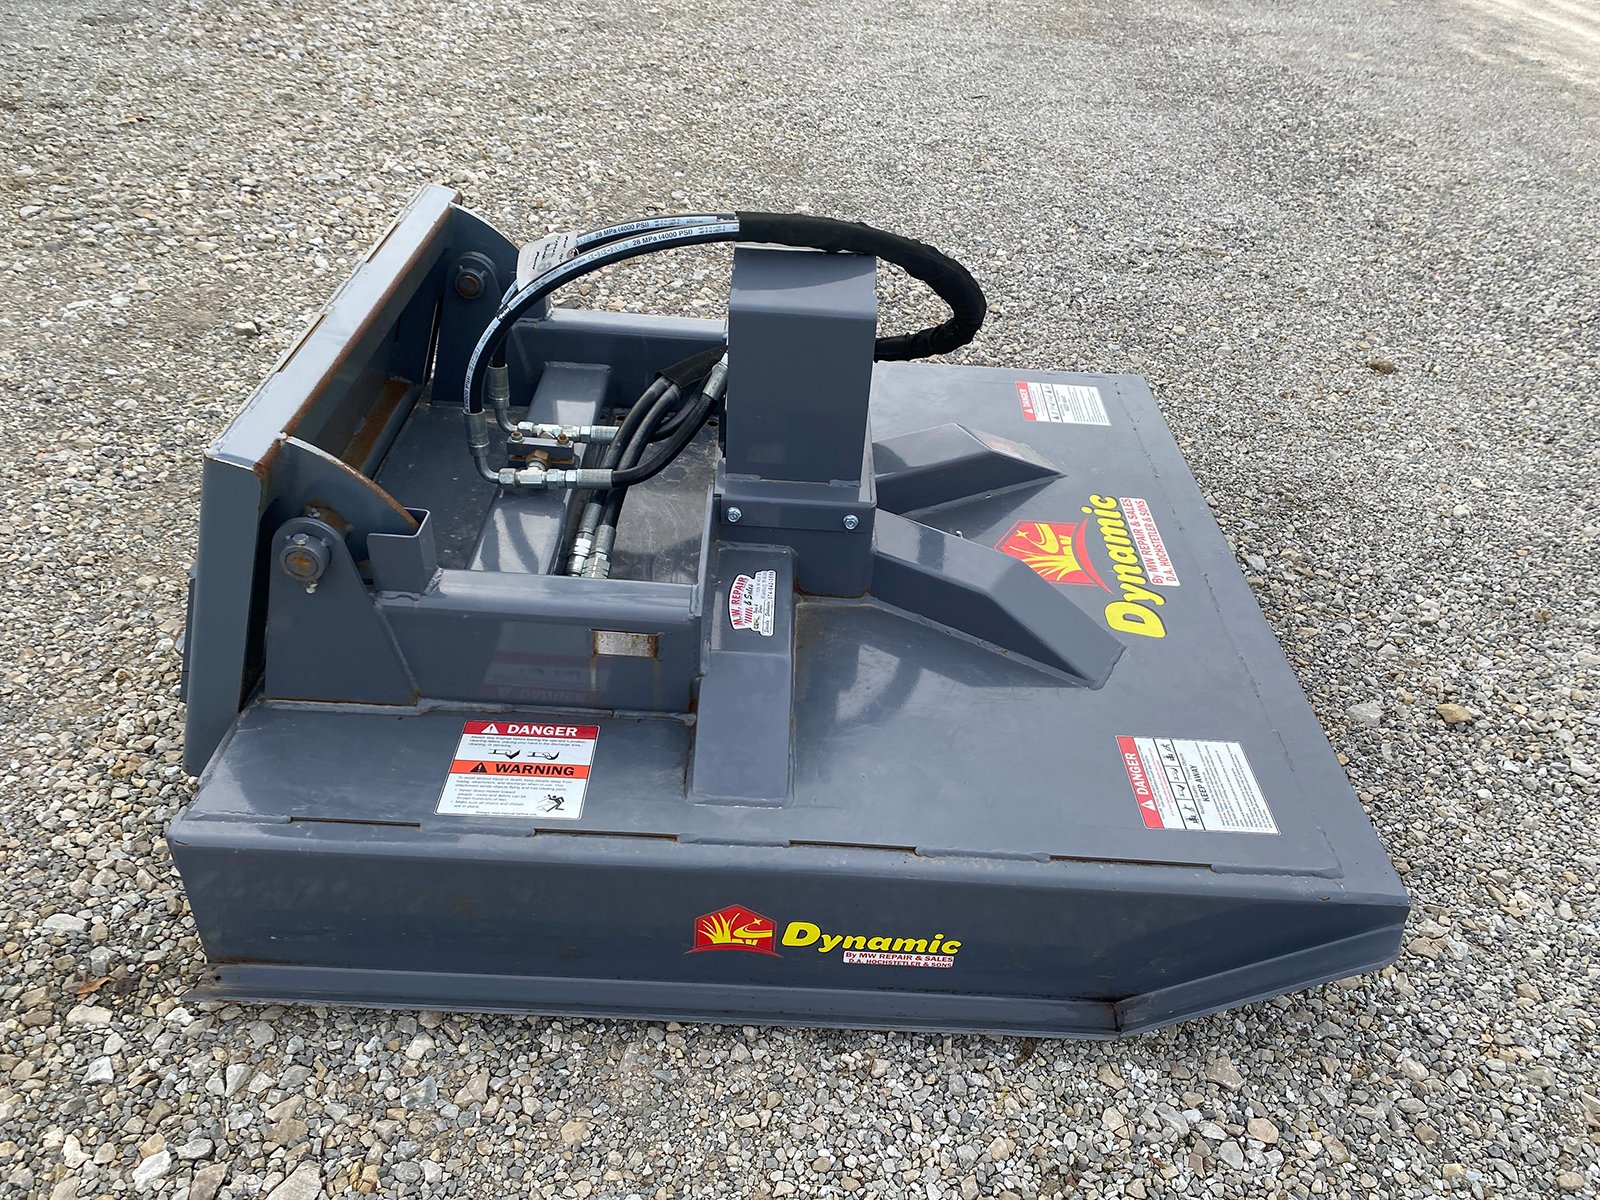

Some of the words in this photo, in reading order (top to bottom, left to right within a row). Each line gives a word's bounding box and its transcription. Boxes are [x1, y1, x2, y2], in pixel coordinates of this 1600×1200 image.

[603, 228, 617, 237] MPa
[617, 224, 635, 233] (4000
[636, 221, 650, 229] PSI)
[642, 234, 657, 244] MPa
[659, 231, 678, 241] (4000
[678, 228, 693, 236] PSI)
[1121, 498, 1138, 520] SALES
[1136, 501, 1149, 516] SONS
[1134, 528, 1151, 555] REPAIR
[1080, 494, 1167, 638] Dynamic
[1145, 558, 1158, 572] MW
[1152, 575, 1164, 584] By
[1163, 569, 1177, 582] D.A.
[731, 577, 747, 605] REPAIR
[744, 584, 754, 600] Sales
[507, 724, 578, 736] DANGER
[496, 763, 575, 776] WARNING
[1124, 752, 1149, 795] DANGER
[1190, 764, 1202, 783] AWAY
[1199, 783, 1211, 802] KEEP
[782, 921, 962, 954] Dynamic
[879, 953, 913, 961] REPAIR
